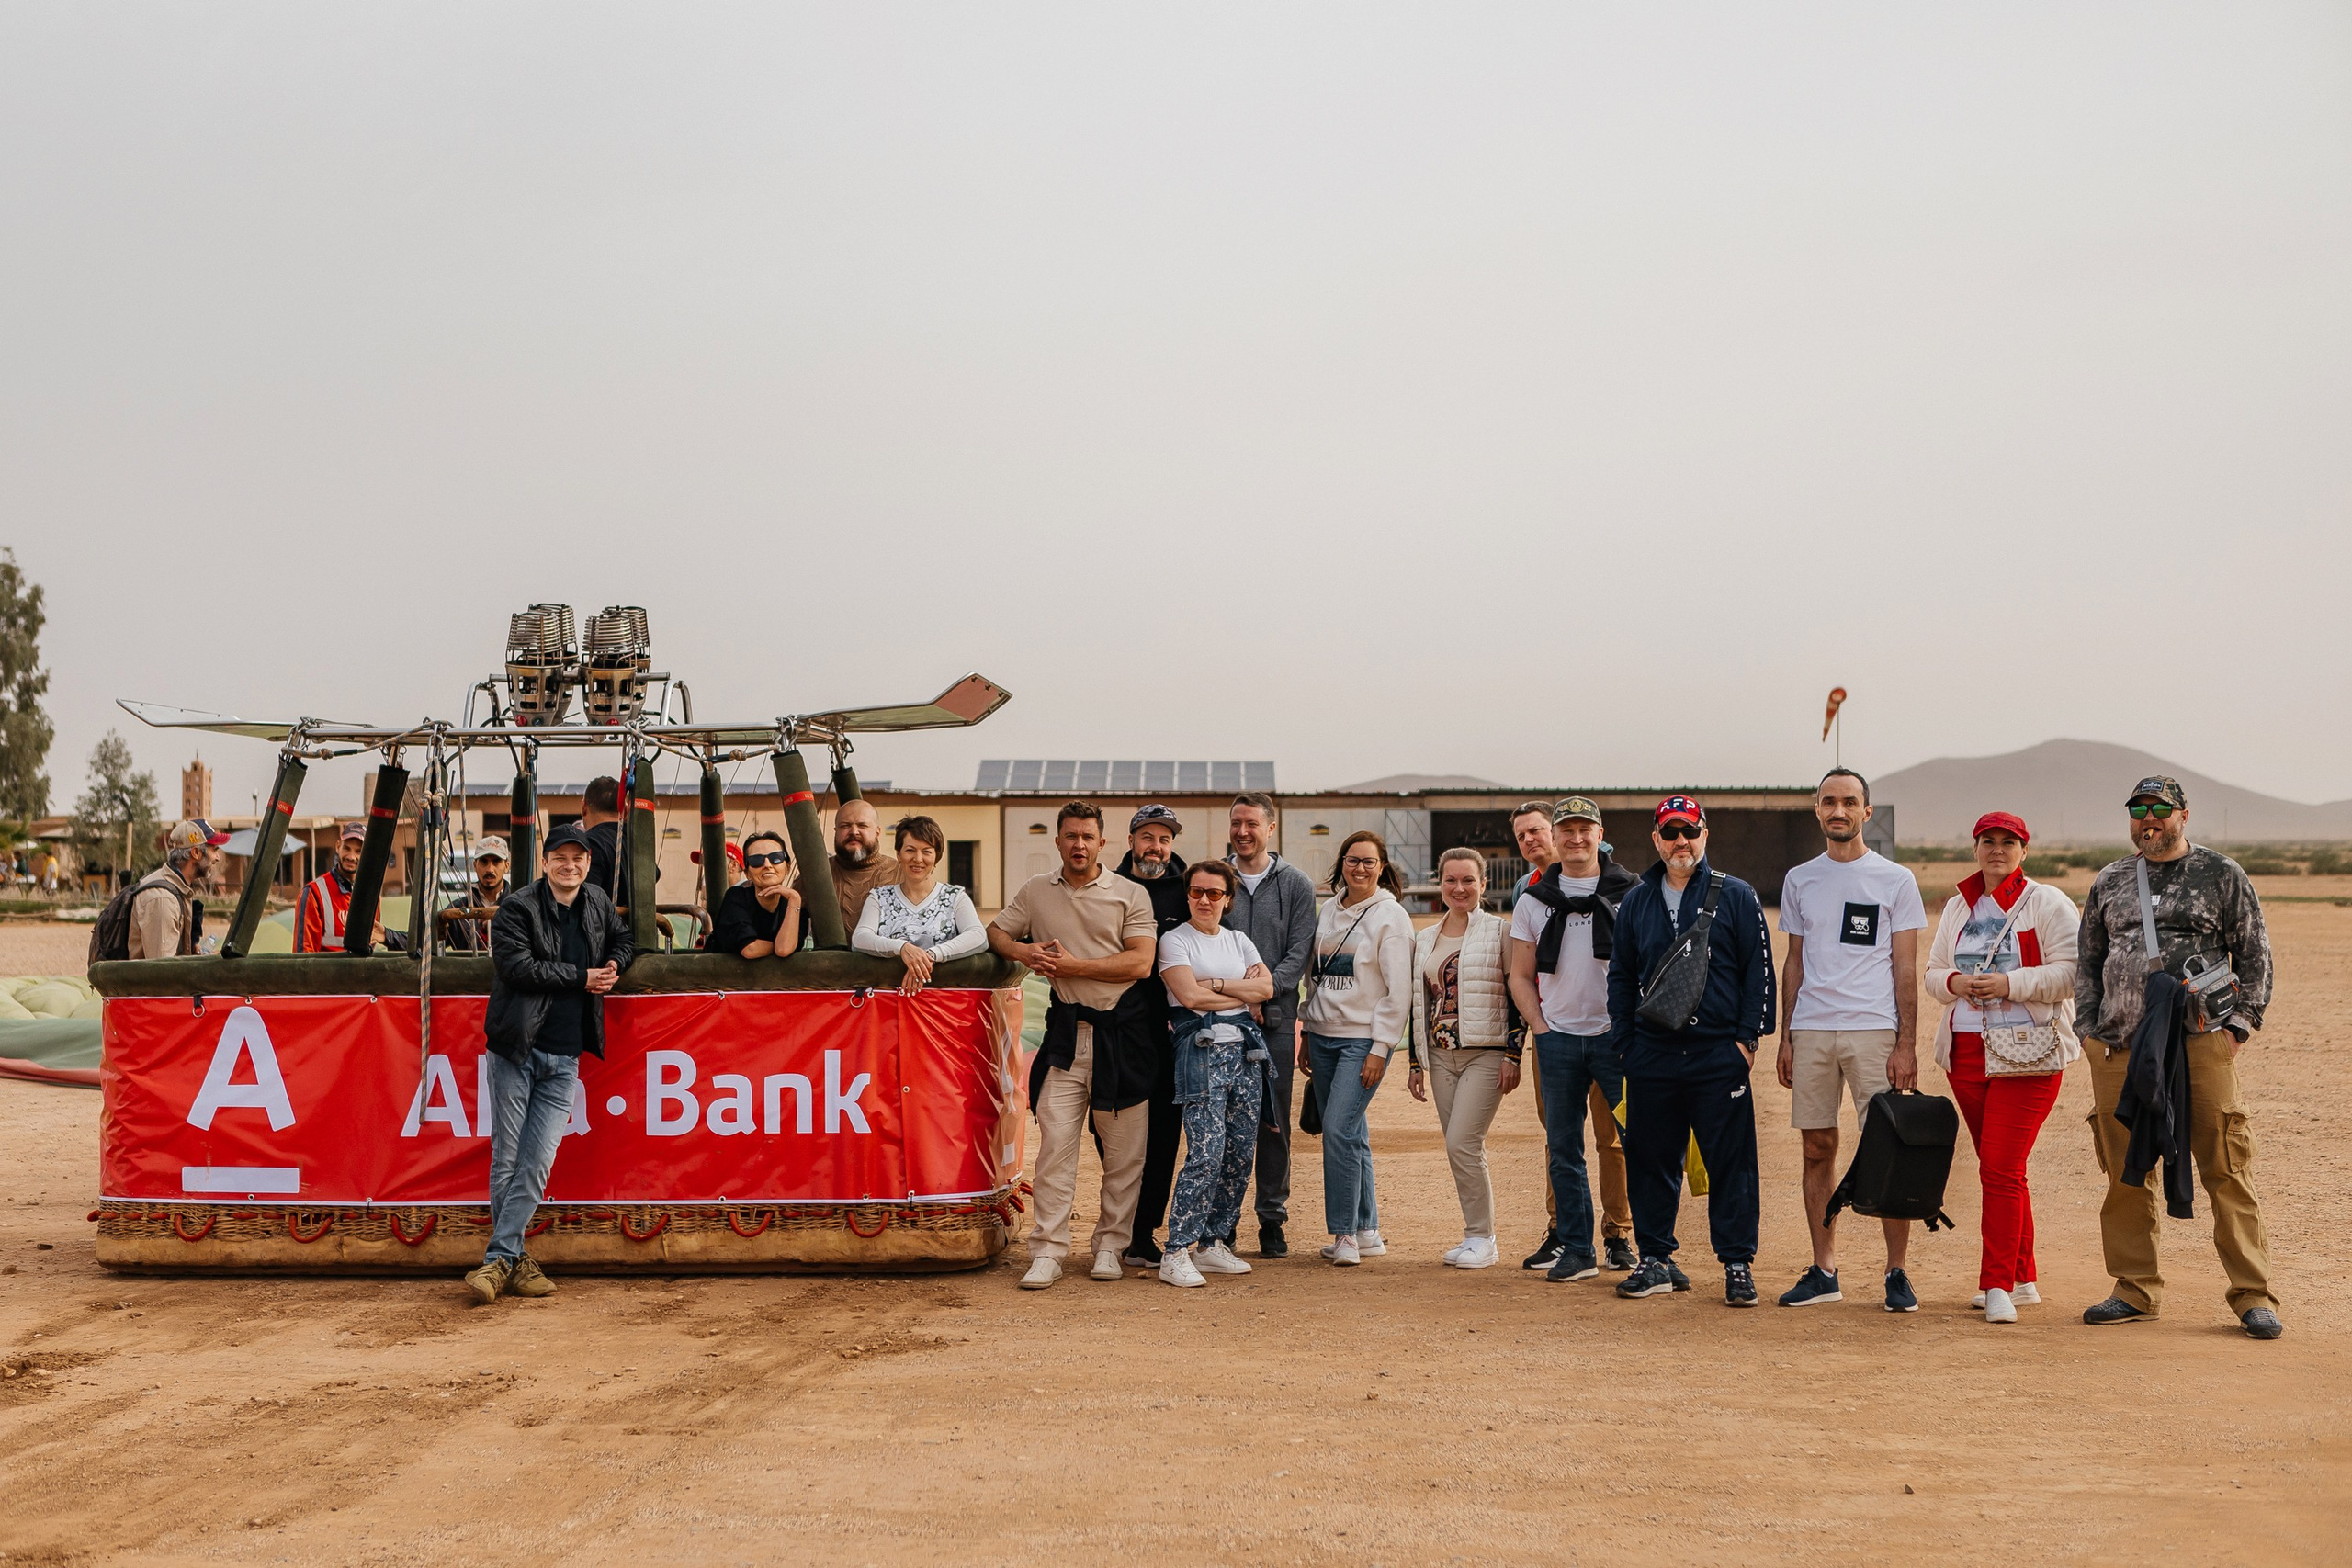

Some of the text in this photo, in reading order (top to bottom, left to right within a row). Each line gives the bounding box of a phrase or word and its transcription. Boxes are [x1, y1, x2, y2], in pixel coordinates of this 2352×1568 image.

[1322, 975, 1354, 990] ORIES
[400, 1049, 872, 1137] Al Bank
